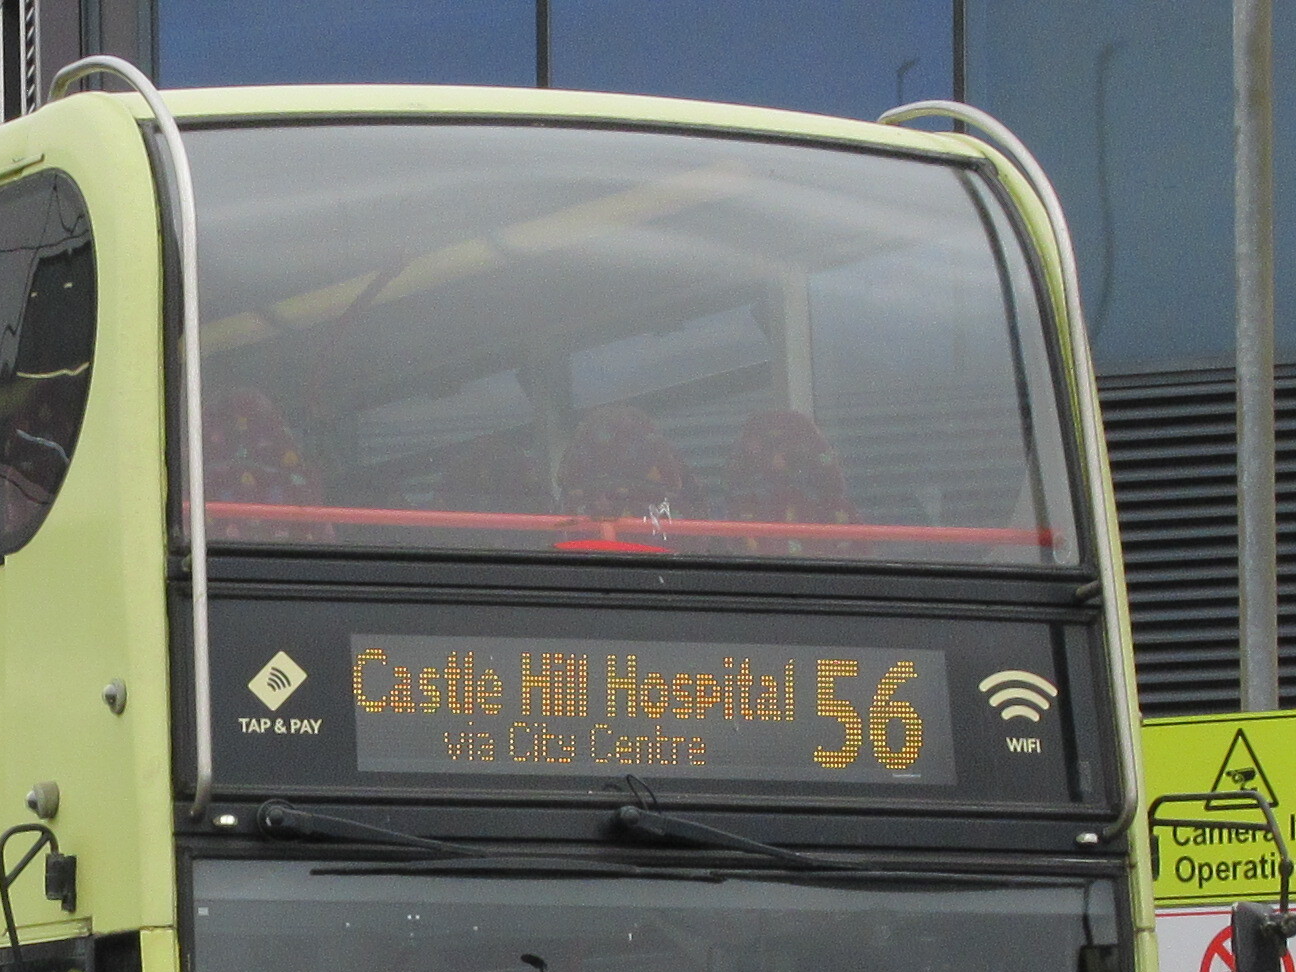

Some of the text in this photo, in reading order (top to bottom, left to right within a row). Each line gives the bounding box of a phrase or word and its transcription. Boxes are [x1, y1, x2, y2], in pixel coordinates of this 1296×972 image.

[353, 648, 795, 721] Castle Hill Hospital
[238, 718, 323, 735] TAP & PAY
[444, 721, 707, 765] via City Centre
[814, 659, 923, 769] 56
